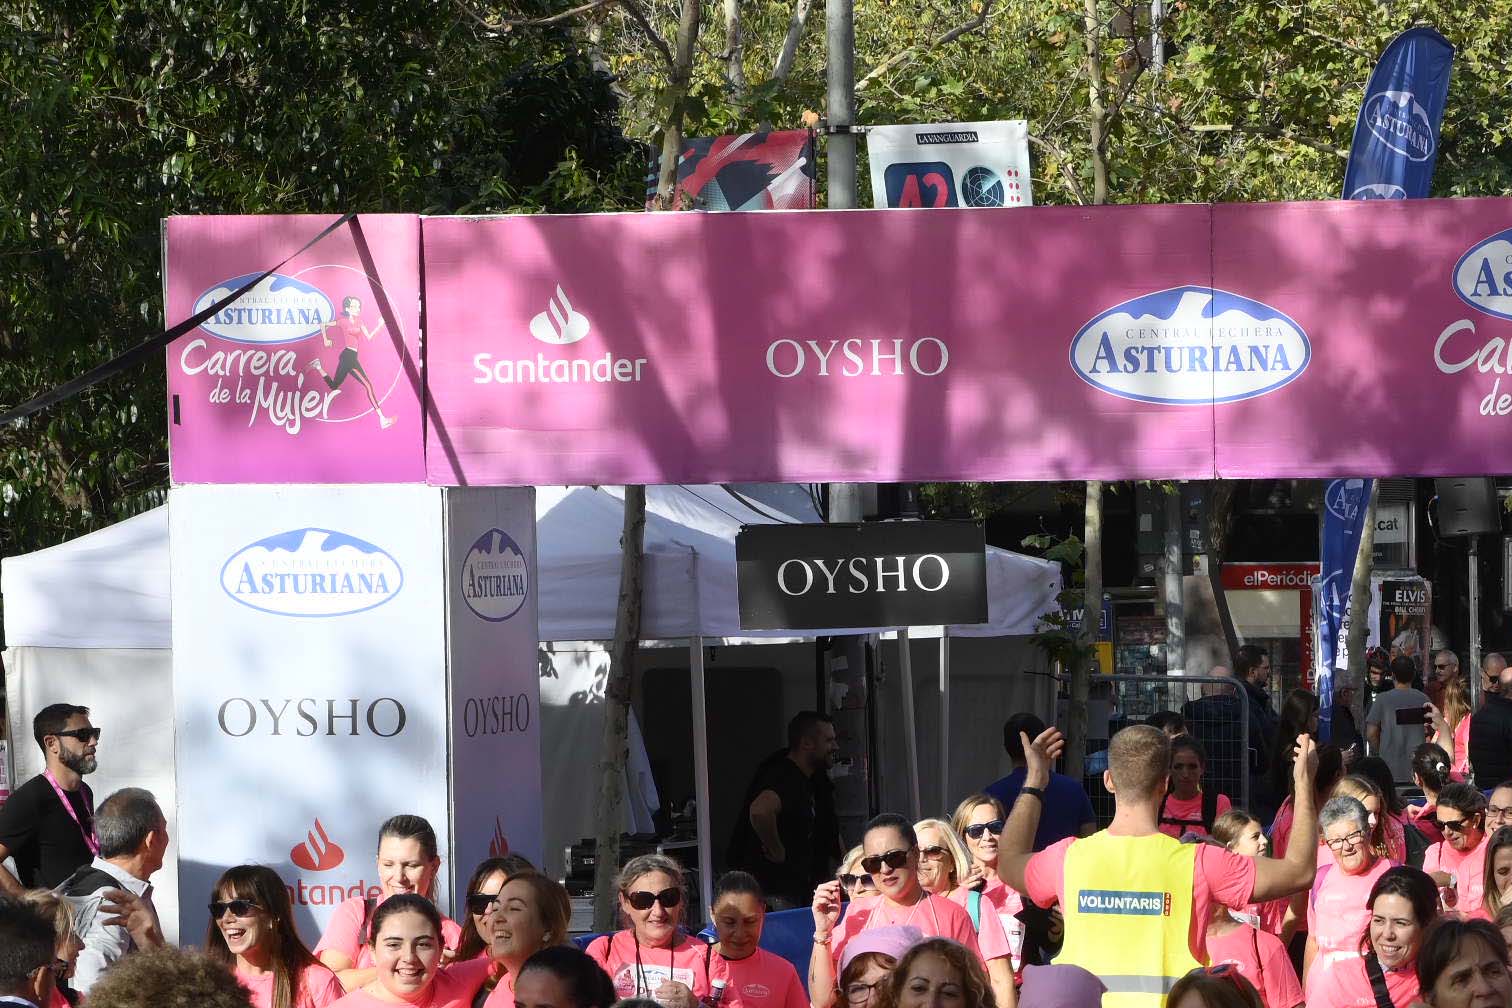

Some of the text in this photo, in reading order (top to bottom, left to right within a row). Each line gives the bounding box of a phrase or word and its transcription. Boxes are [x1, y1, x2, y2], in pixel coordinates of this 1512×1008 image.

[1126, 326, 1285, 339] CENTRAL LECHERA
[180, 339, 297, 376] Carrera
[473, 351, 647, 384] Santander
[766, 337, 949, 377] OYSHO
[1089, 331, 1292, 374] ASTURIANA
[209, 372, 342, 435] de la Mujer
[1479, 378, 1512, 415] de
[235, 560, 390, 595] ASTURIANA
[467, 562, 525, 600] ASTURIANA
[777, 554, 950, 596] OYSHO
[1395, 590, 1426, 602] ELVIS
[217, 697, 407, 738] OYSHO
[464, 693, 530, 738] OYSHO
[1078, 895, 1162, 911] VOLUNTARIS
